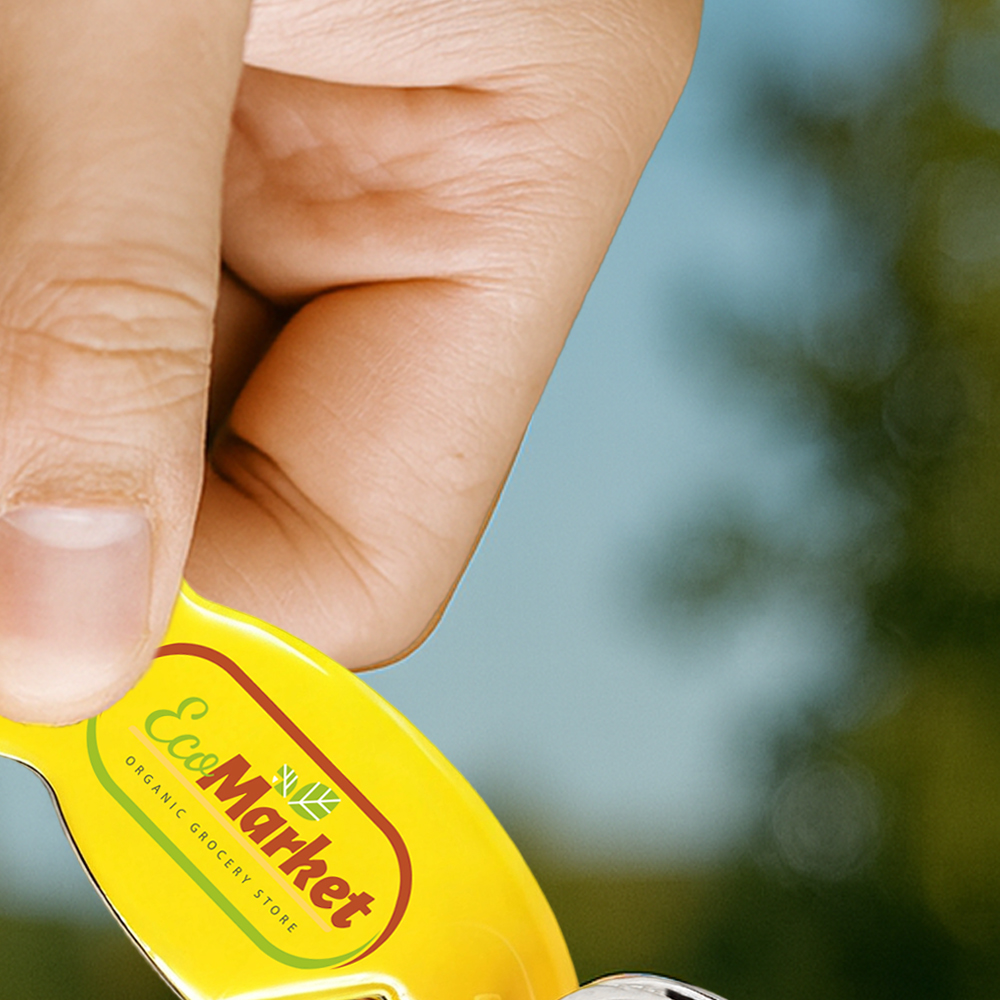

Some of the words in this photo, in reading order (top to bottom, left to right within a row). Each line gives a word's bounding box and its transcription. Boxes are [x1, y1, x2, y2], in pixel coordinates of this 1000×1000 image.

[125, 755, 187, 819] ORGANIC
[189, 822, 252, 885] GROCERY
[253, 888, 298, 933] STORE
